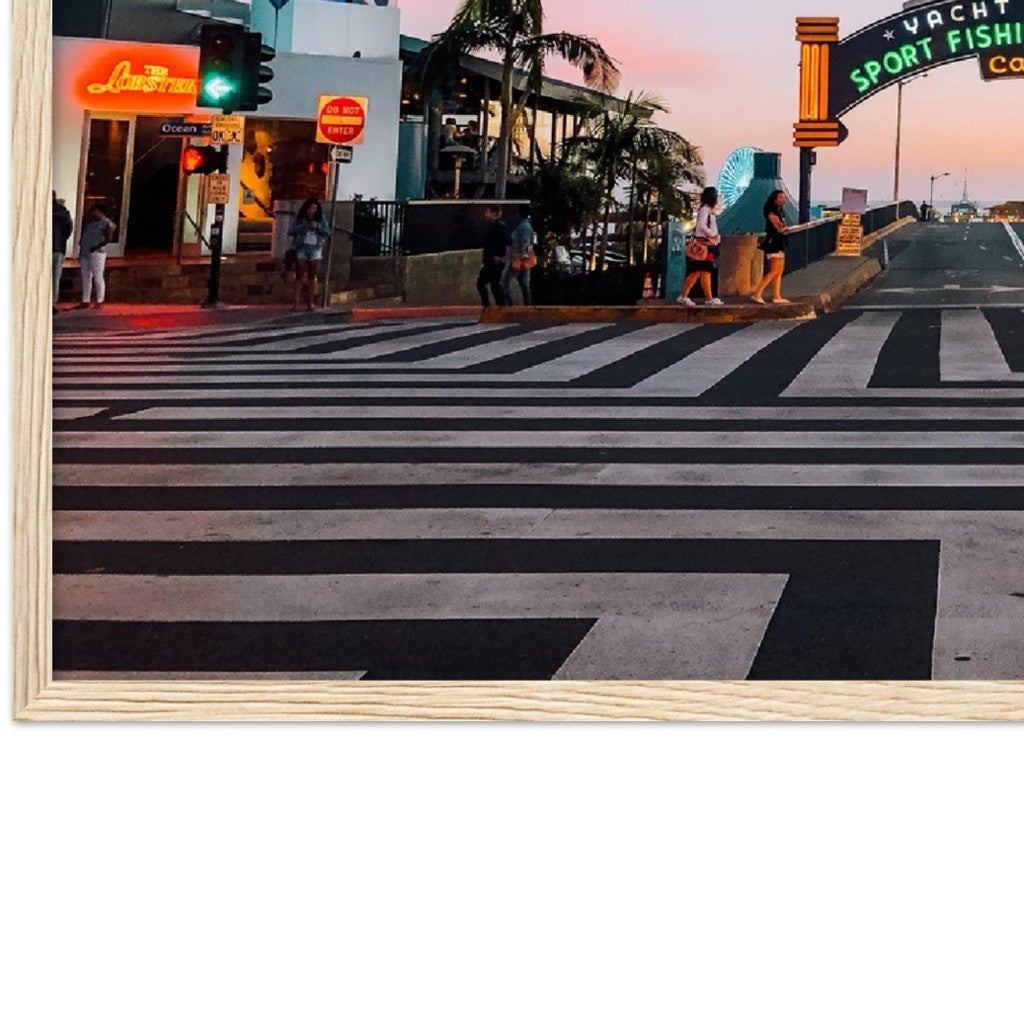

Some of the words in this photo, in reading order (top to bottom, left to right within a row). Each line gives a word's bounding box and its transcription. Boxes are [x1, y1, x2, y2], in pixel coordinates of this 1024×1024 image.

[850, 37, 932, 93] SPORT
[143, 64, 169, 77] THE
[326, 105, 339, 114] DO
[342, 106, 360, 115] NOT
[162, 123, 198, 133] Ocean
[327, 126, 355, 135] ENTER
